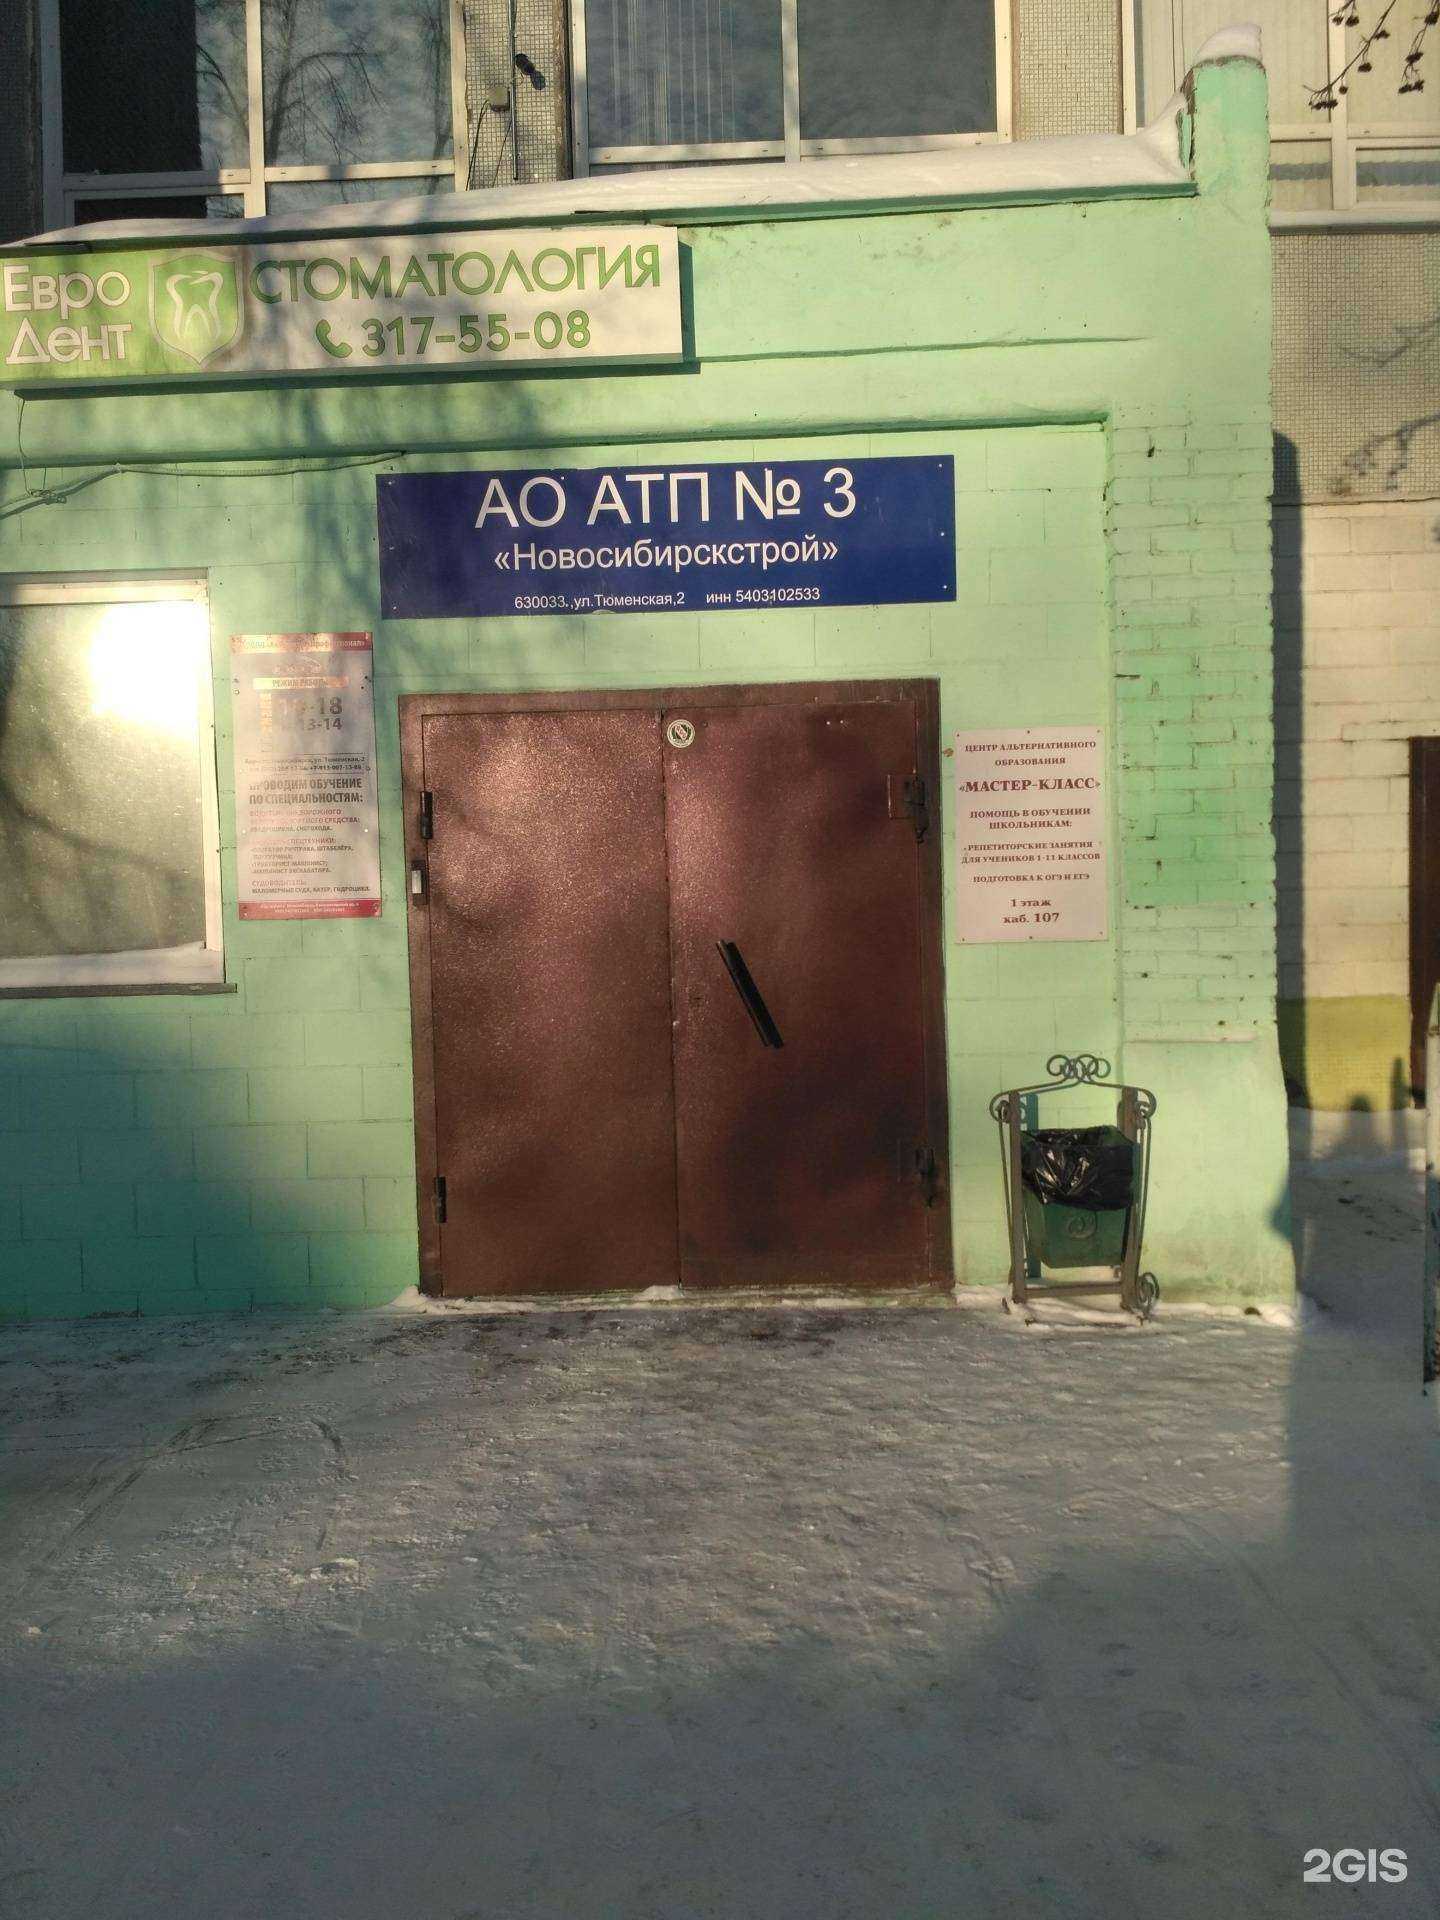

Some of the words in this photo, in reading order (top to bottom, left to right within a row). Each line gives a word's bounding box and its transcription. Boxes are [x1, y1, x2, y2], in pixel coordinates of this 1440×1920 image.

[251, 244, 661, 304] СТОМАТОЛОГИЯ
[3, 264, 132, 320] Евро
[361, 309, 591, 357] 317-55-08
[5, 317, 133, 364] Дент
[474, 476, 567, 529] АО
[586, 472, 710, 526] АТП
[735, 468, 801, 521] №
[823, 467, 856, 518] 3
[494, 533, 839, 573] «Новосибирскстрой»
[706, 592, 731, 604] инн
[735, 588, 821, 602] 5403102533
[965, 743, 999, 752] ЦЕНТР
[1000, 740, 1097, 752] АЛЬТЕРНАТИВНОГО
[994, 757, 1067, 767] ОБРАЗОВАНИЯ
[310, 778, 363, 791] ОБУЧЕНИЕ
[959, 777, 1101, 793] «МАСТЕР-КЛАСС»
[969, 810, 1020, 820] ПОМОЩЬ
[1022, 809, 1030, 818] В
[1031, 807, 1091, 817] ОБУЧЕНИИ
[1049, 841, 1093, 849] ЗАНЯТИЯ
[961, 856, 983, 864] ДЛЯ
[984, 854, 1035, 863] УЧЕНИКОВ
[1058, 853, 1100, 861] КЛАССОВ
[973, 876, 1034, 884] ПОДГОТОВКА
[1003, 914, 1030, 924] каб.
[1034, 912, 1060, 923] 107
